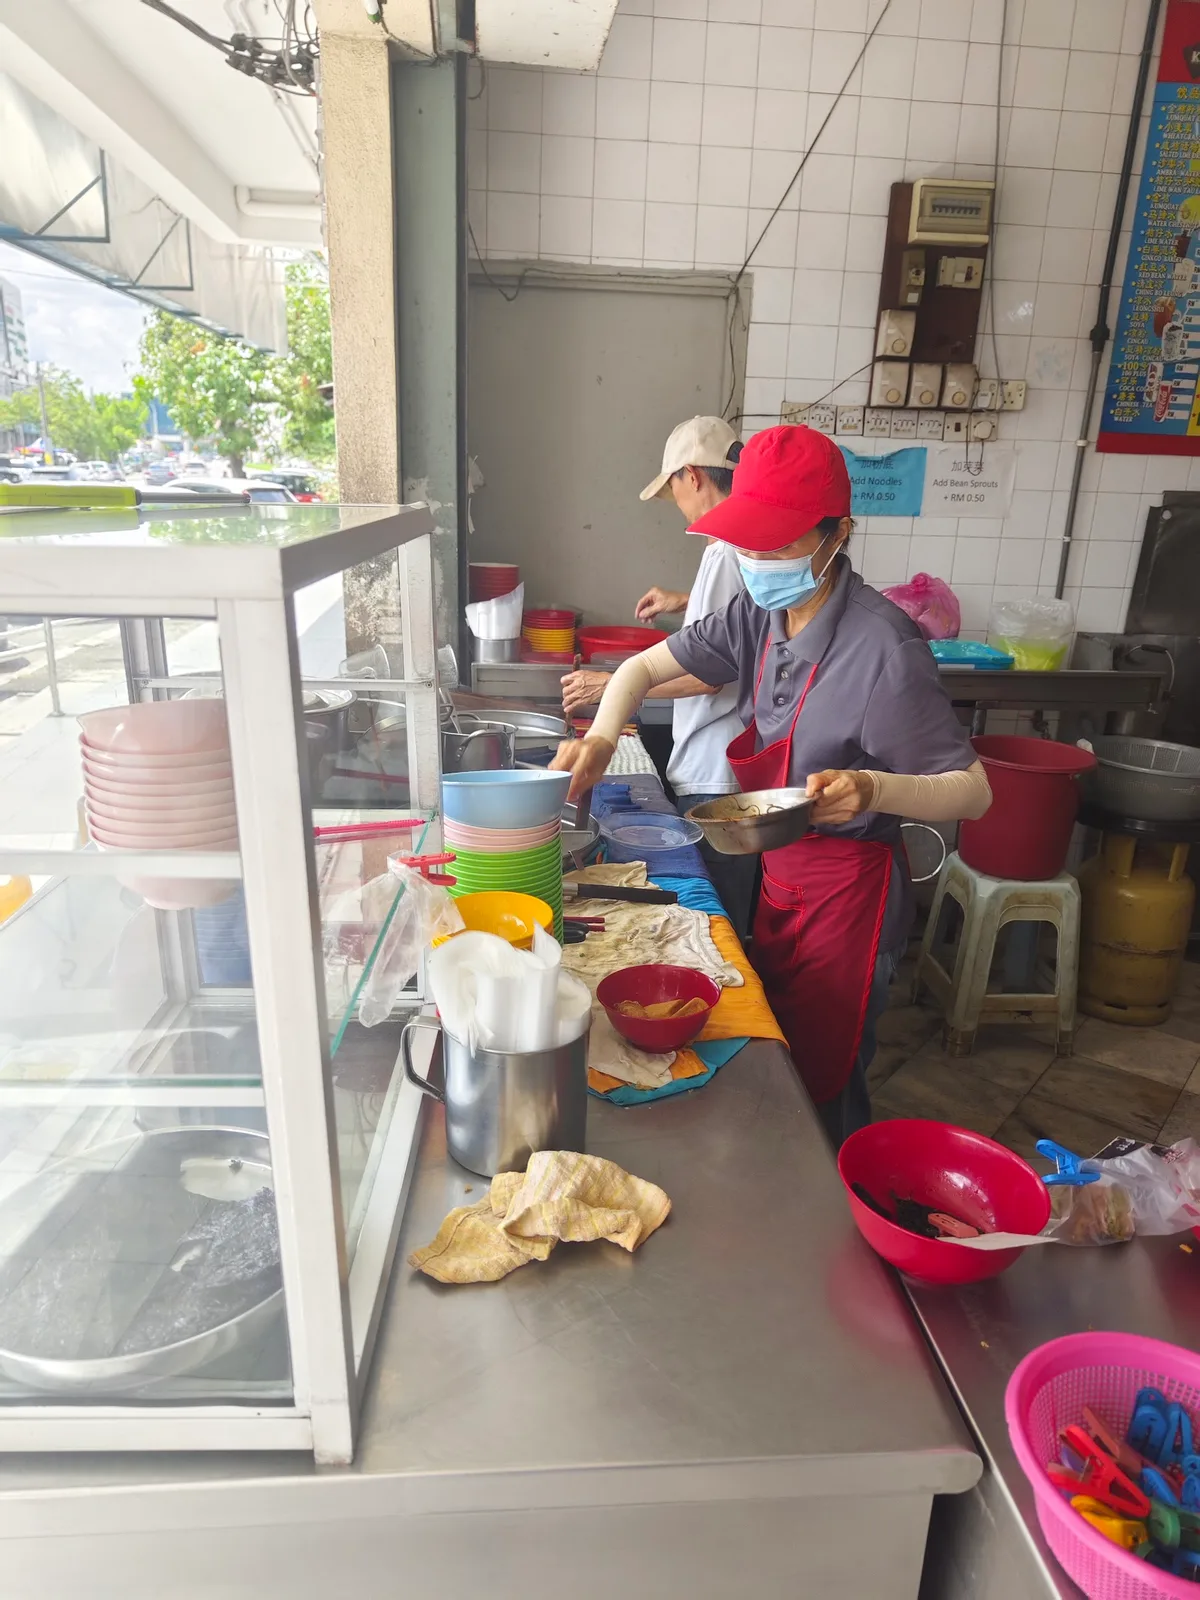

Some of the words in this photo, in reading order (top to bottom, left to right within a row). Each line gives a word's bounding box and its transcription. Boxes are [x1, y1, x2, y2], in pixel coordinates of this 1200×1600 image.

[850, 476, 866, 485] Add
[868, 477, 903, 486] Noodles
[932, 479, 949, 487] Add
[950, 479, 969, 487] Bean
[970, 479, 998, 489] Sprouts
[860, 492, 875, 500] RM
[877, 492, 896, 501] 0.50
[950, 493, 965, 502] RM
[966, 493, 985, 503] 0.50
